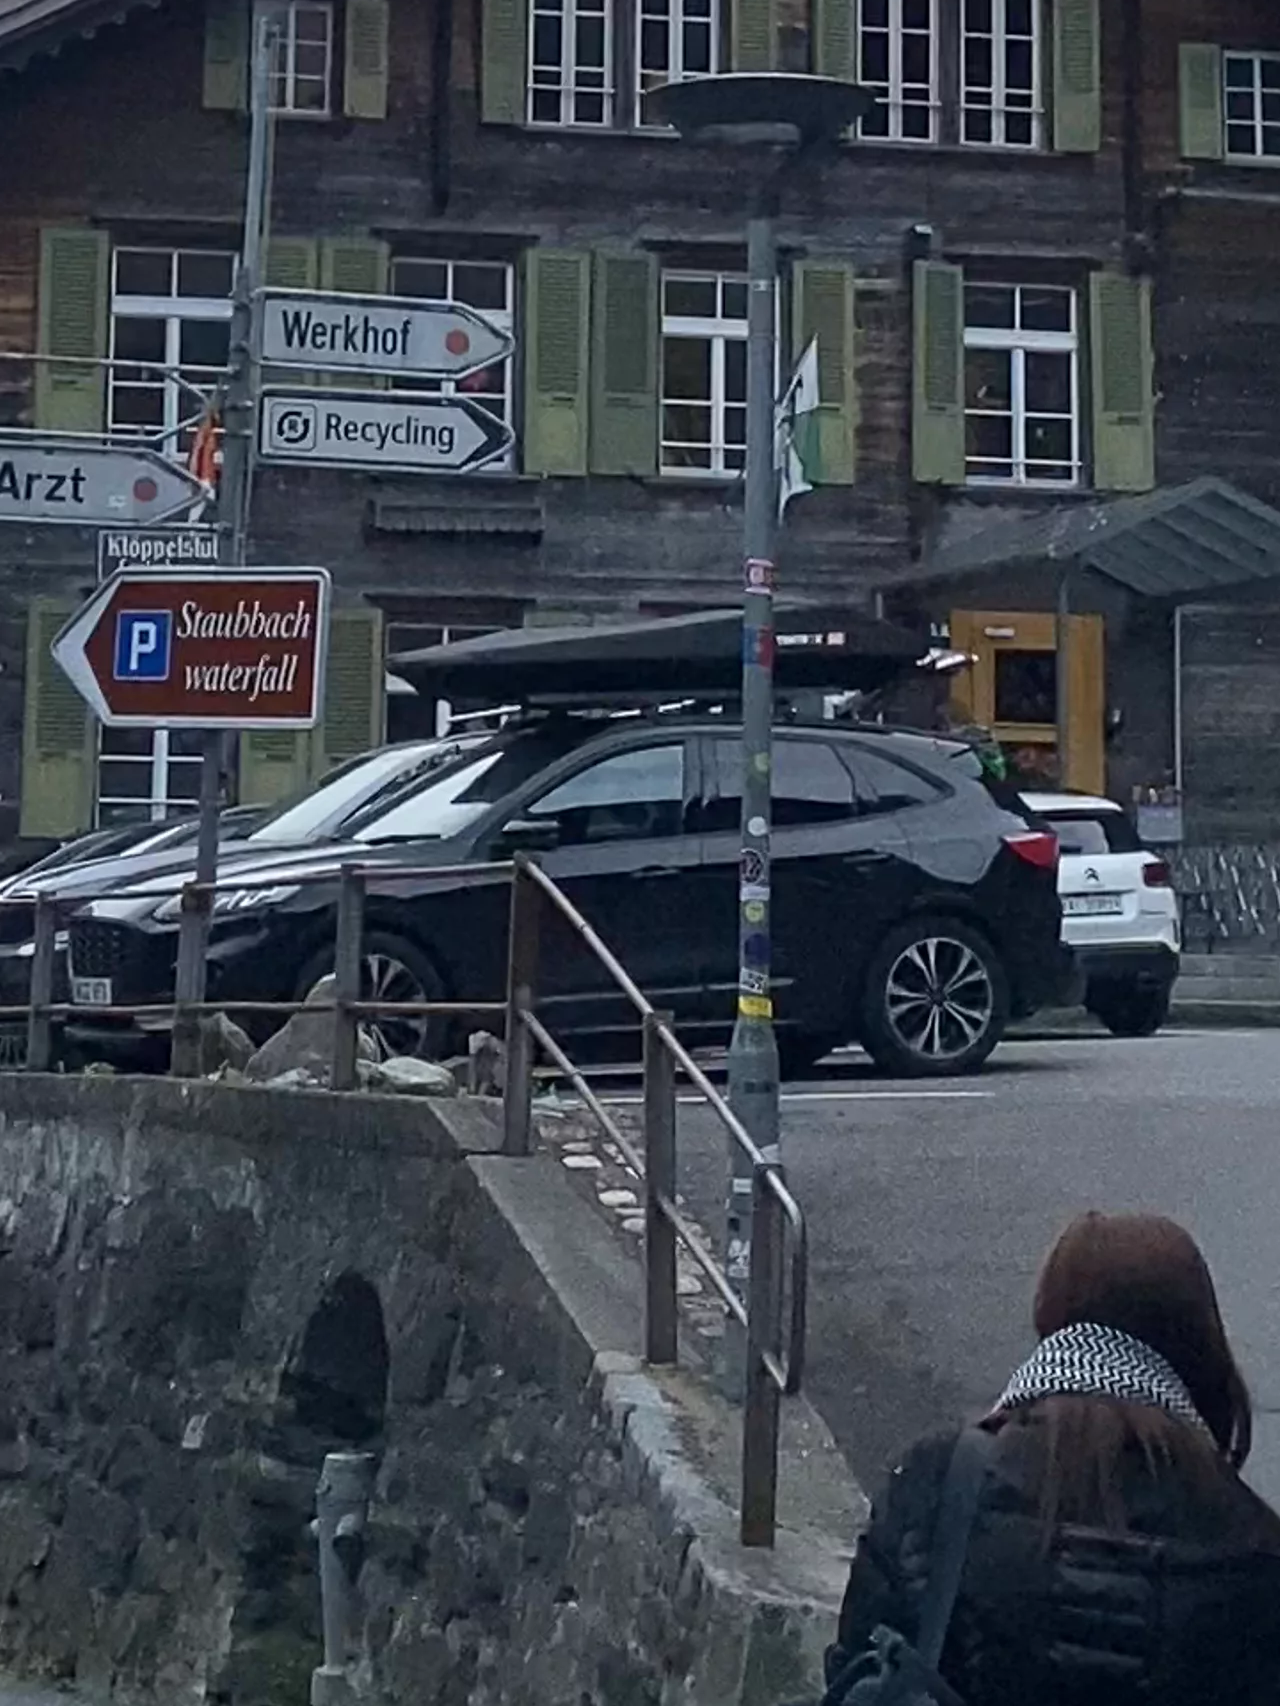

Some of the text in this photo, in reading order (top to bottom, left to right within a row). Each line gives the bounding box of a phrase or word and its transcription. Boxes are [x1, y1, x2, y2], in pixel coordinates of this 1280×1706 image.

[282, 310, 412, 355] Werkhof
[325, 412, 455, 454] Recycling
[176, 600, 311, 639] Staubbach
[129, 621, 157, 671] P
[185, 653, 299, 702] waterfall
